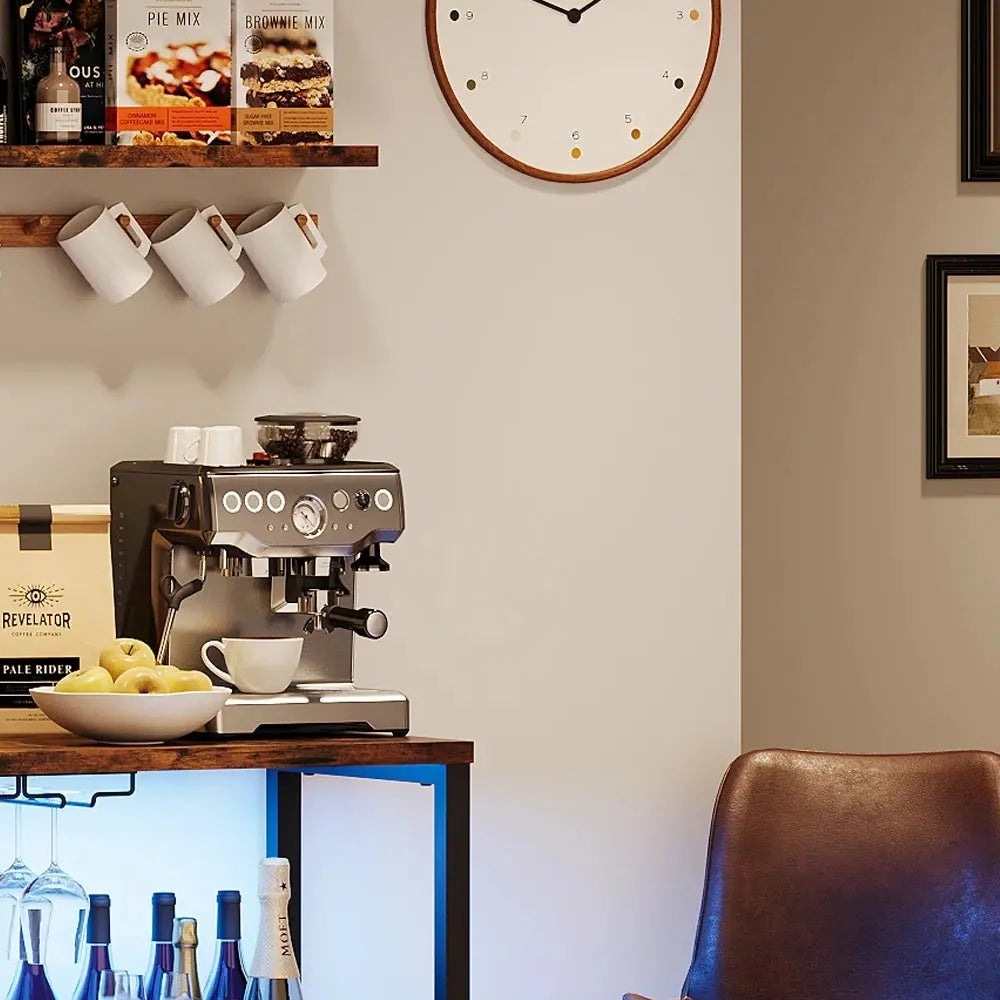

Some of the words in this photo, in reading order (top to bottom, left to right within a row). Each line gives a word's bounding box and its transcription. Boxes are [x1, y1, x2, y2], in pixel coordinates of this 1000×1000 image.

[147, 11, 169, 27] PIE
[176, 11, 201, 27] MIX
[466, 11, 474, 20] 9
[676, 11, 684, 20] 3
[245, 15, 299, 30] BROWNIE
[304, 15, 325, 30] MIX
[481, 71, 489, 81] 8
[661, 70, 670, 80] 4
[520, 115, 528, 125] 7
[624, 114, 632, 124] 5
[572, 131, 580, 141] 6
[2, 612, 71, 629] REVELATOR
[2, 664, 32, 675] PALE
[35, 664, 73, 675] RIDER
